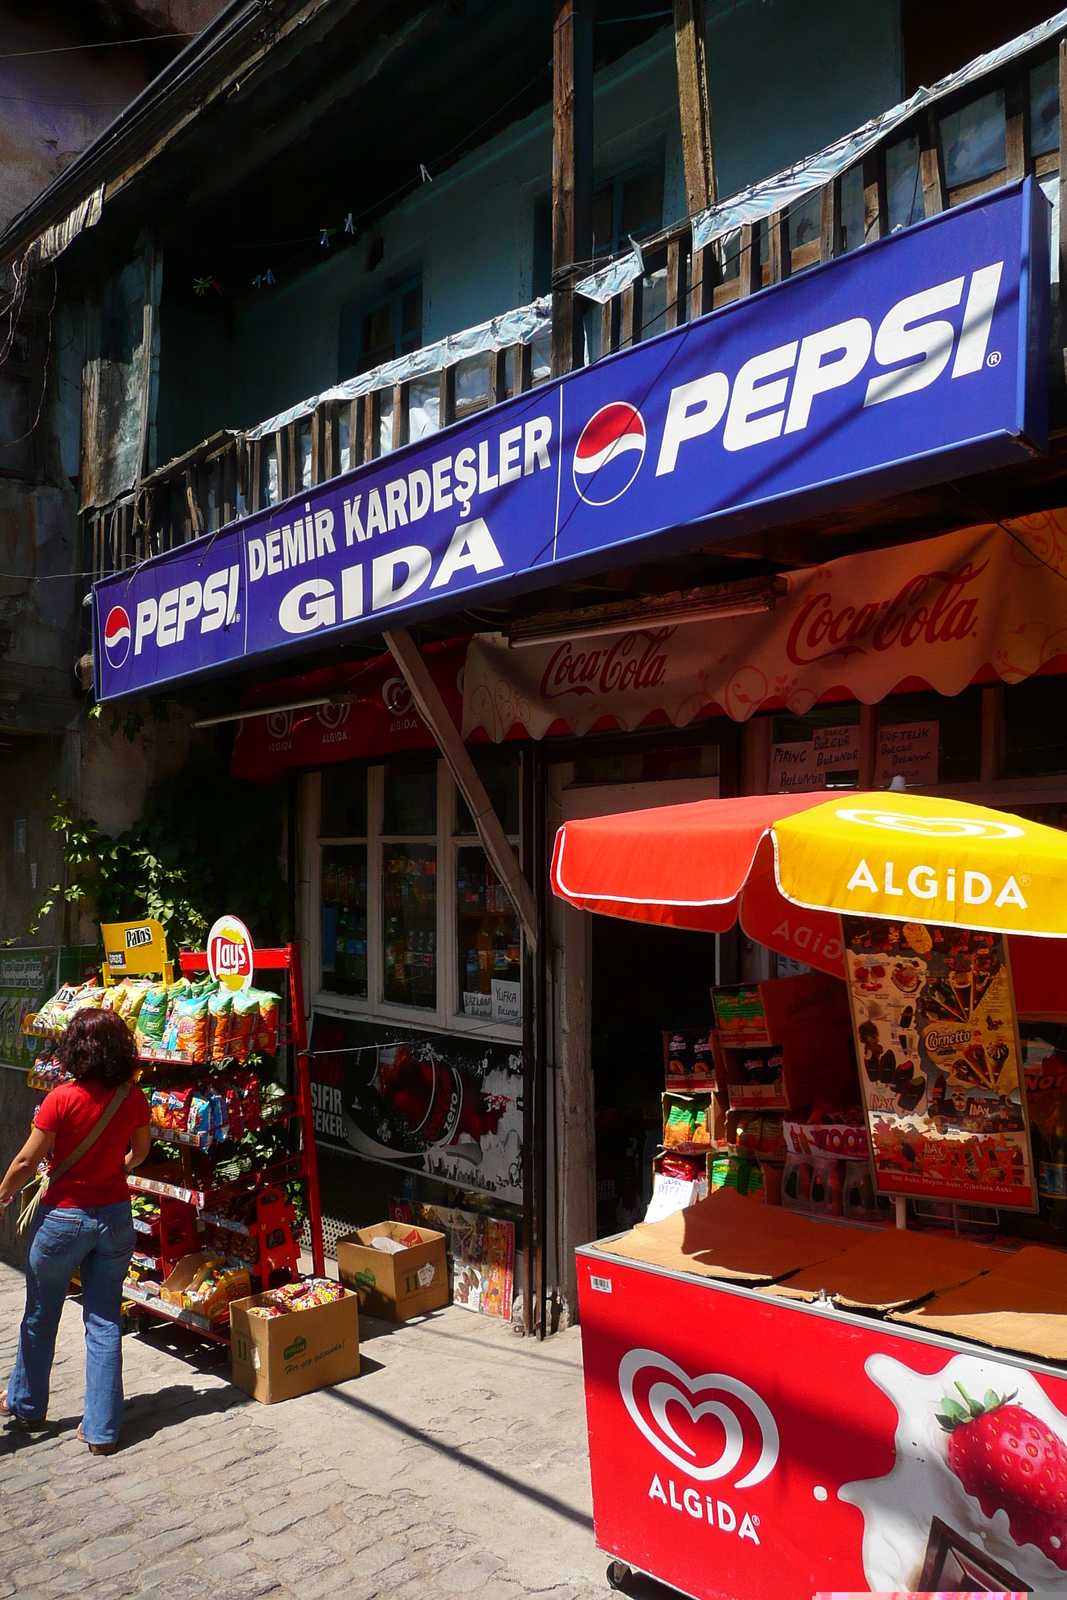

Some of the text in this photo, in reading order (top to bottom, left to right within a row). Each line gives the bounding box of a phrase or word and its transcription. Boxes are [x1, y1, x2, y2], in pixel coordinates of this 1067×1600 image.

[656, 261, 1004, 477] PEPSI
[249, 416, 552, 582] DEMİR KARDEŞLER
[279, 518, 504, 634] GIDA
[135, 564, 240, 655] PEPSI
[495, 986, 517, 1004] YUFKA
[925, 1029, 971, 1052] Cornetto
[310, 1081, 343, 1116] SIFIR
[443, 1091, 459, 1131] zero
[921, 1177, 943, 1188] Meyve
